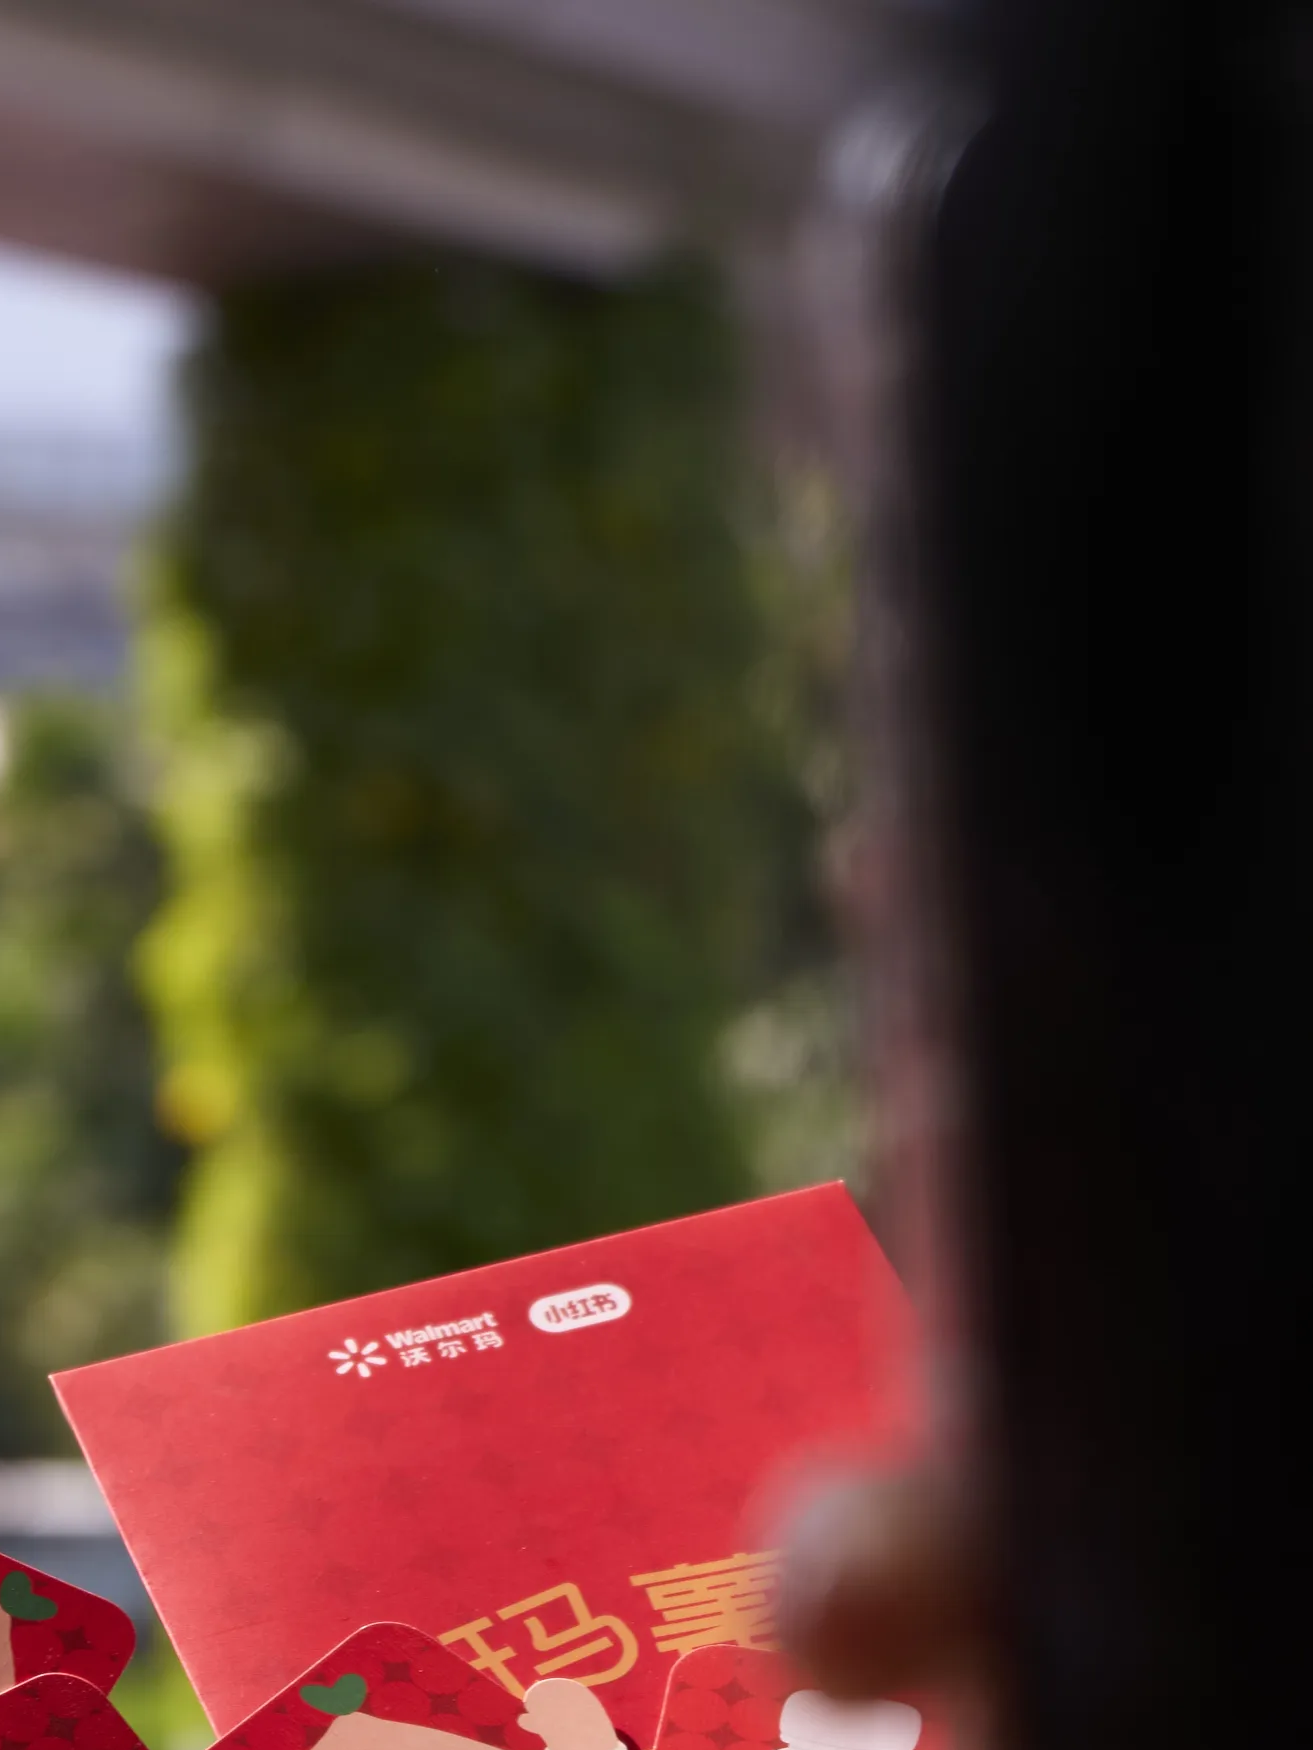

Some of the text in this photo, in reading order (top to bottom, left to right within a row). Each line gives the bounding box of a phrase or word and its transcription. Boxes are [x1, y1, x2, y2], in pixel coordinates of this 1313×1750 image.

[545, 1293, 618, 1324] 小红书
[385, 1311, 499, 1349] Walmart
[400, 1330, 504, 1368] 沃尔玛
